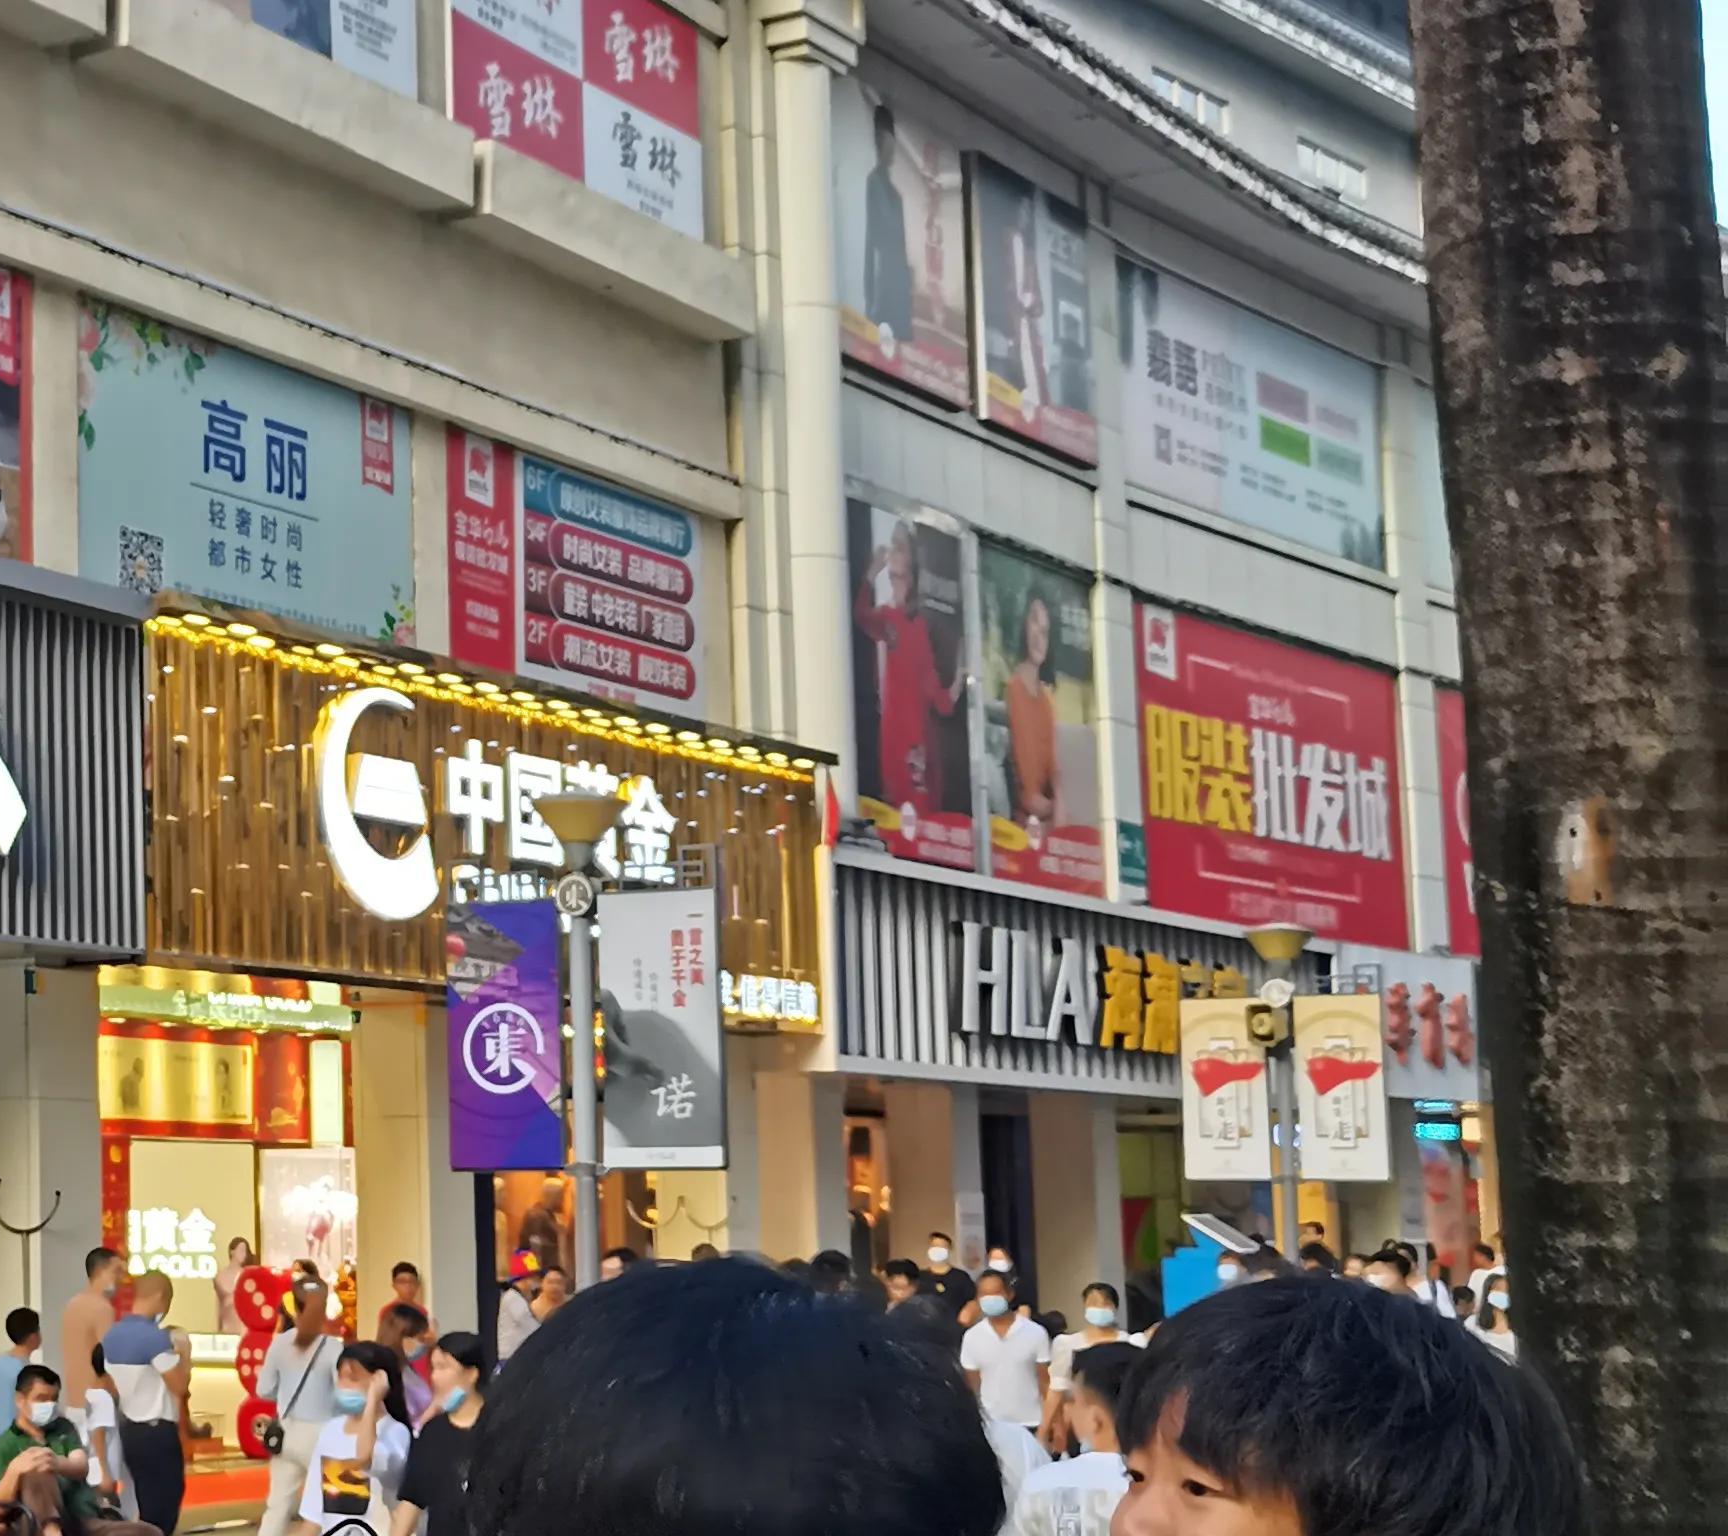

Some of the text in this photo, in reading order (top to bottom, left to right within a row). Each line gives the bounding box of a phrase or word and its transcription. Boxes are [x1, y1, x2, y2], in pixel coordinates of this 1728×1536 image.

[200, 399, 308, 501] 高丽
[208, 498, 303, 553] 轻奢时尚
[208, 537, 303, 590] 都市女性
[526, 569, 547, 594] 3F
[527, 620, 547, 645] 2F
[1144, 701, 1393, 862] 服装批发城
[961, 921, 1094, 1046] HLA
[650, 1072, 697, 1120] 诺
